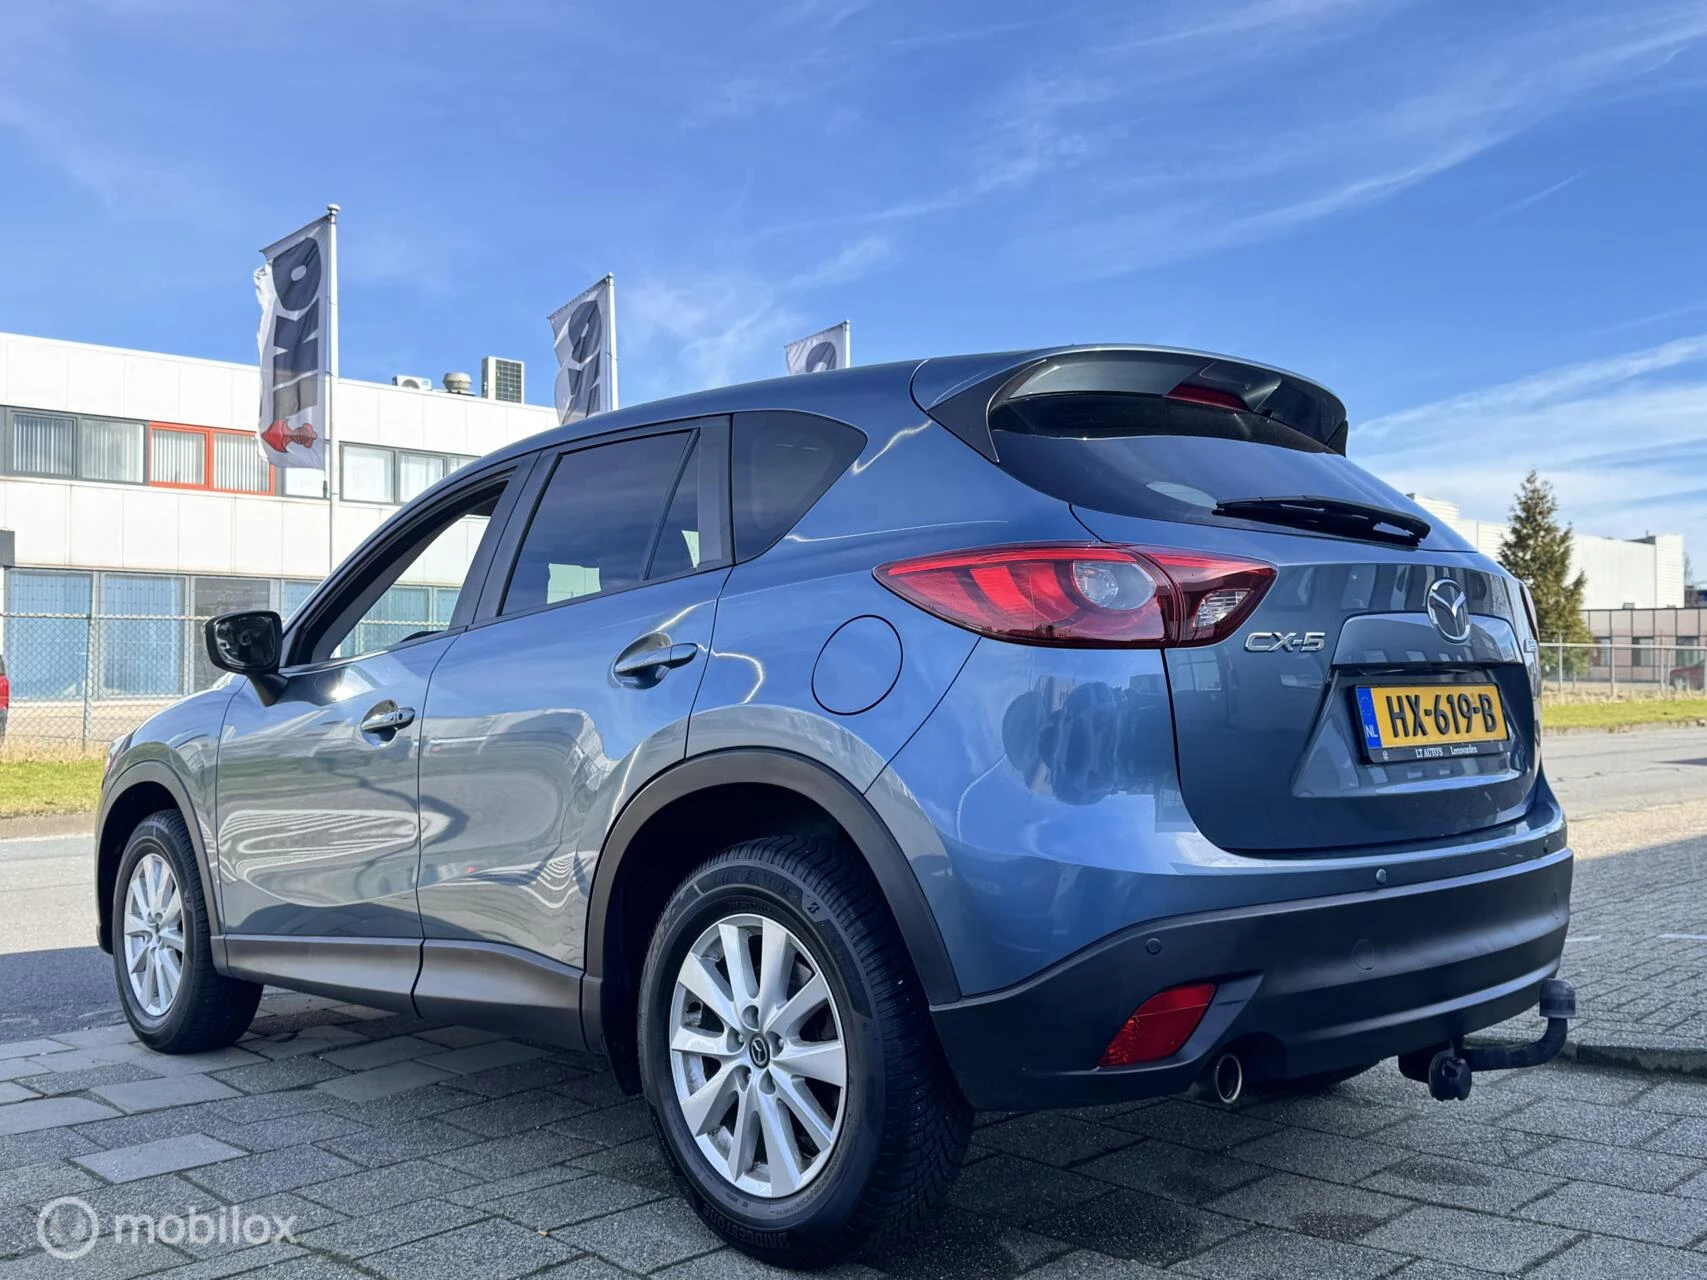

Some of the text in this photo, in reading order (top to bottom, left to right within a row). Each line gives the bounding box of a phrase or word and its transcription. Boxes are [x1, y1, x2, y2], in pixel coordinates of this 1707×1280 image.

[1245, 632, 1326, 652] CX-5
[1385, 693, 1497, 738] HX-619-B
[1365, 724, 1379, 738] NL
